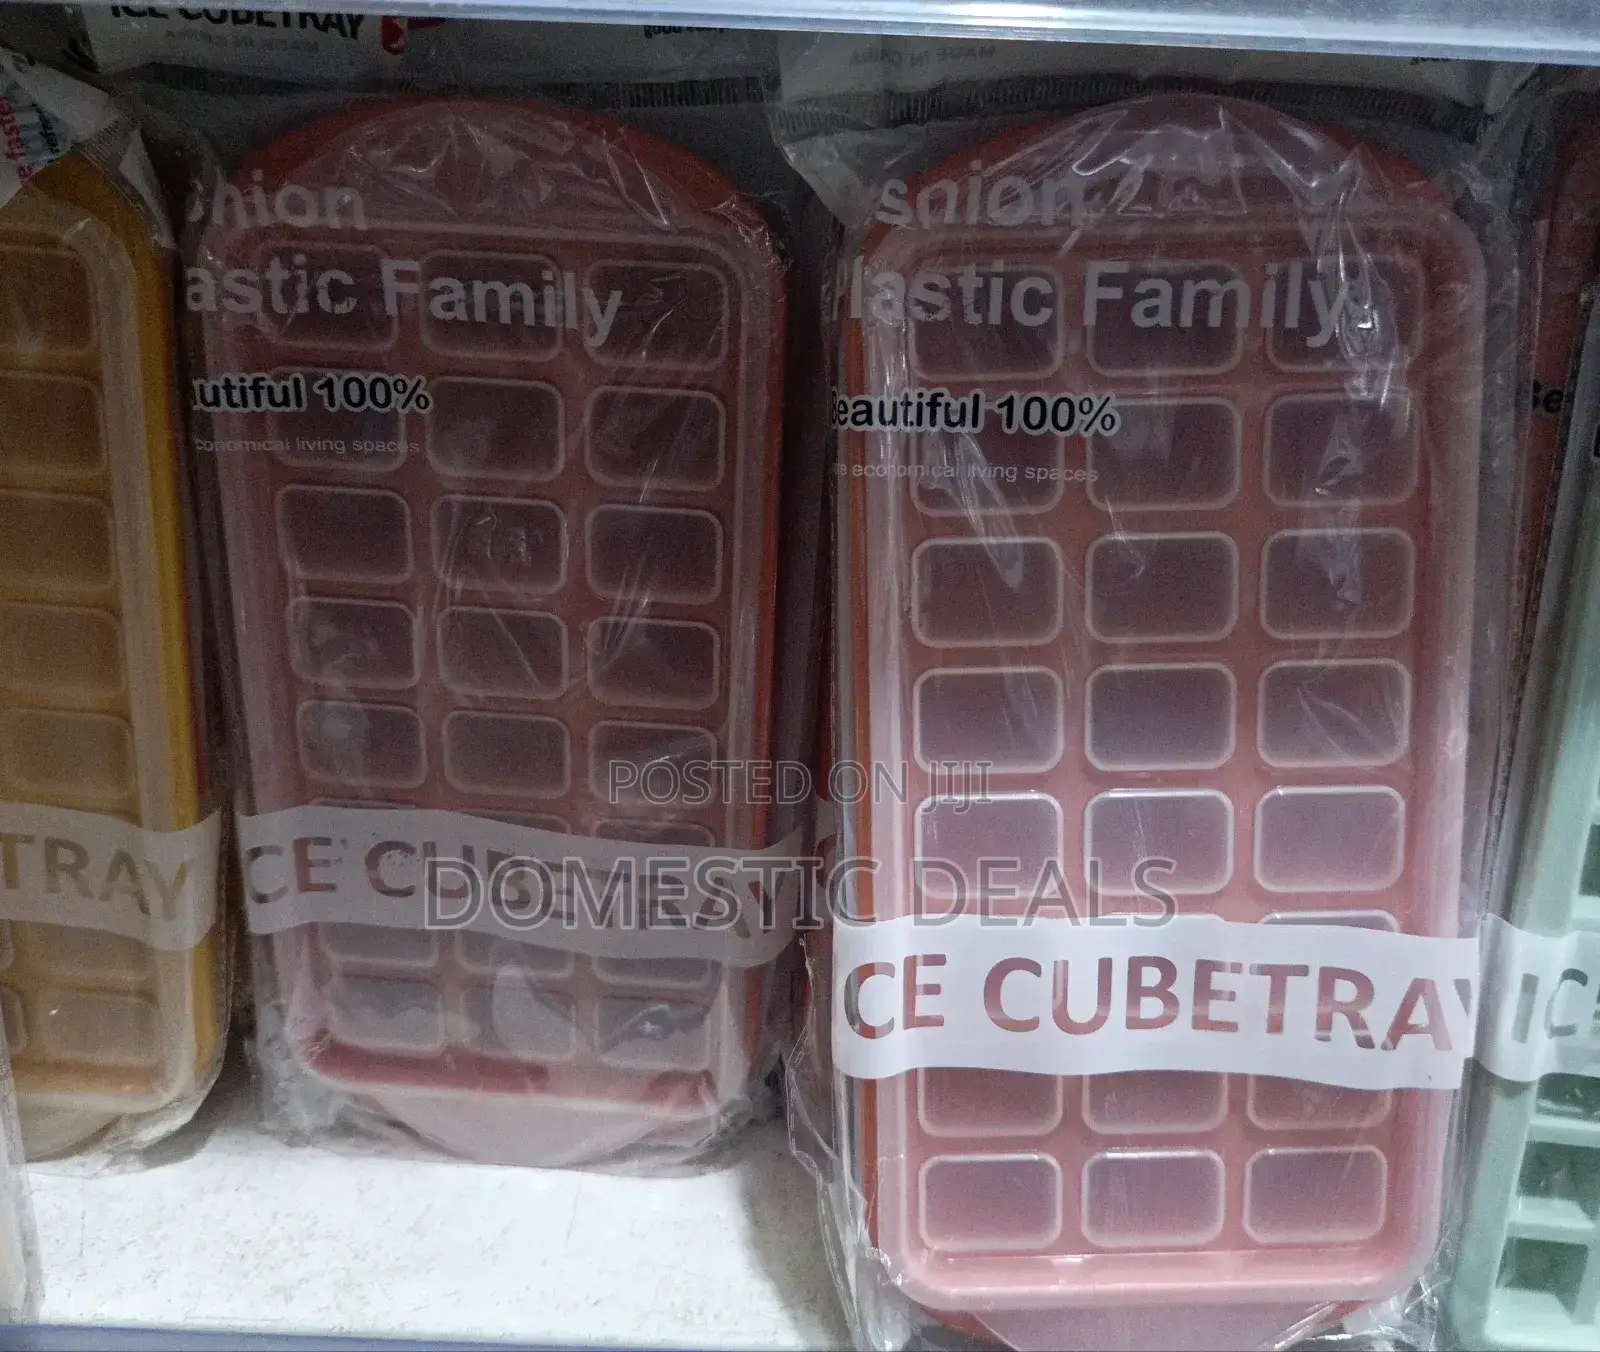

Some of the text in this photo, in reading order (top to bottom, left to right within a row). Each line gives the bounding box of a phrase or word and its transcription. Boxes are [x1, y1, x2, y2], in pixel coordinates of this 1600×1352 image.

[380, 258, 623, 349] Family
[1083, 260, 1350, 348] Family
[315, 374, 432, 413] 100%
[996, 394, 1117, 433] 100%
[297, 437, 346, 454] living
[352, 440, 420, 455] spaces
[1024, 465, 1099, 483] spaces
